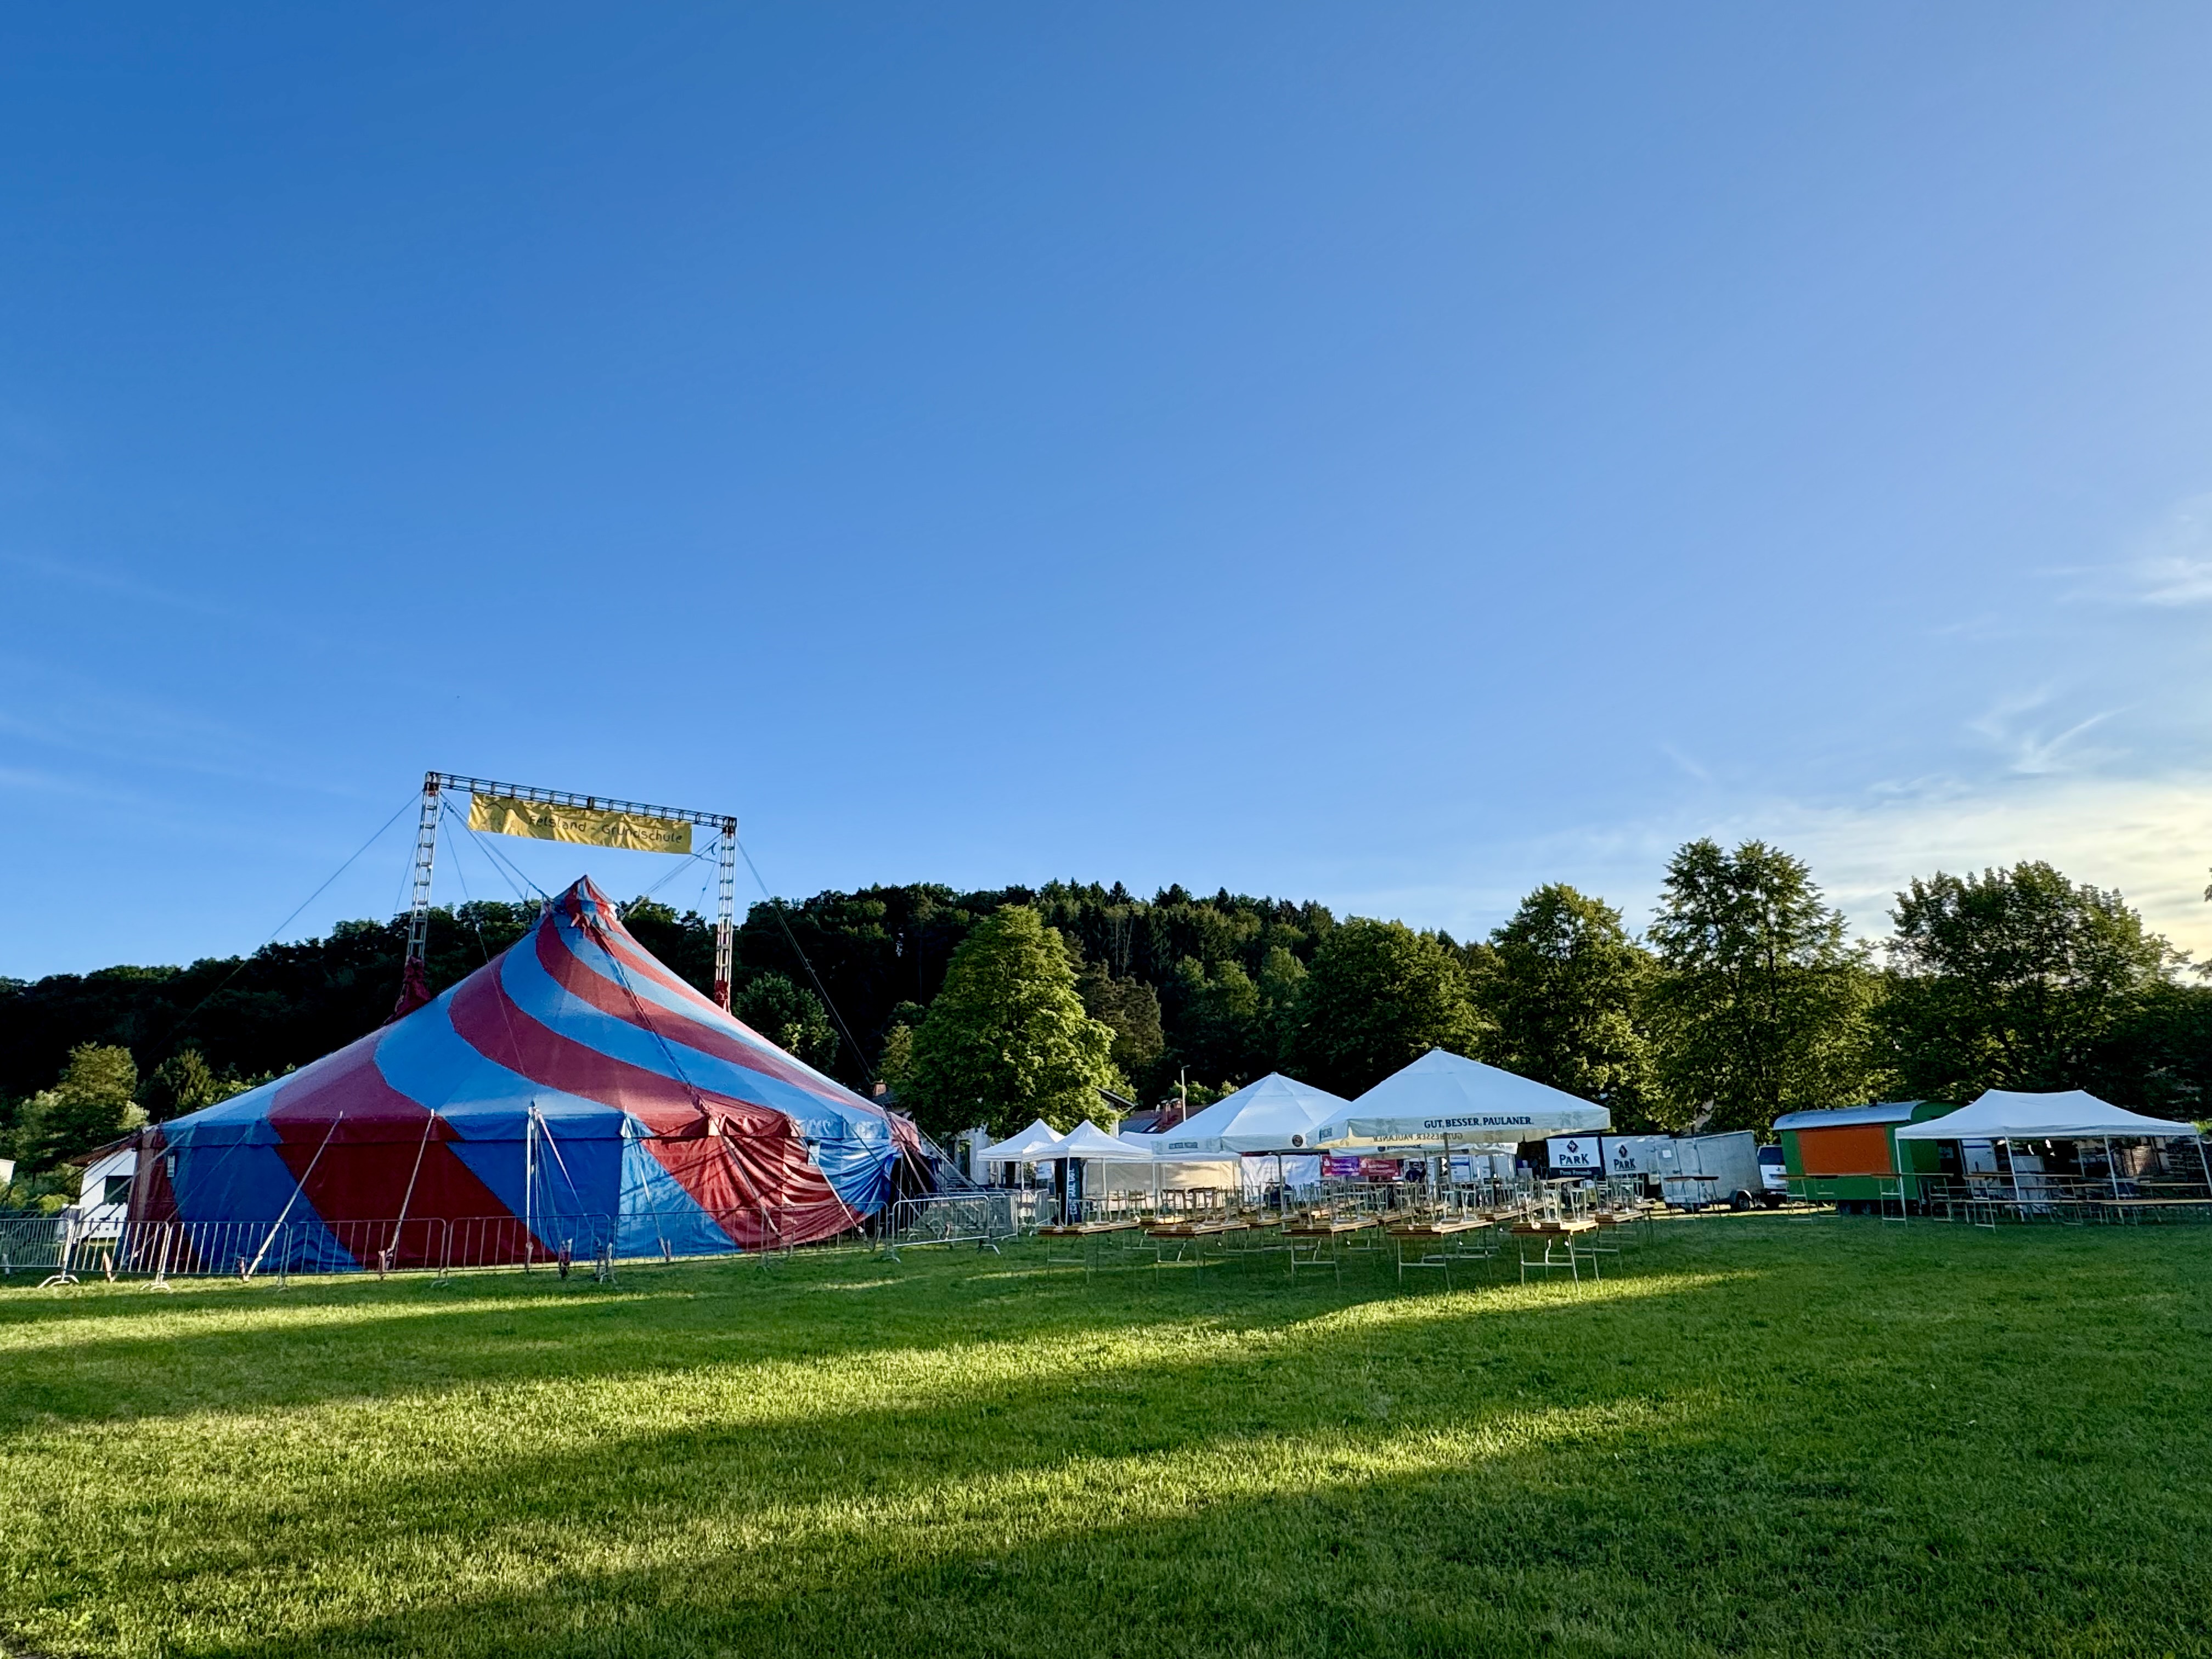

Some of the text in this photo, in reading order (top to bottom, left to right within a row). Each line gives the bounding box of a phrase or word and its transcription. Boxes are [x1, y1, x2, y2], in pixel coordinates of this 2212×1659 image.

[529, 815, 587, 832] Felsland
[601, 824, 682, 844] Grundschule
[1559, 1153, 1590, 1165] PARK
[1613, 1158, 1637, 1171] PARK
